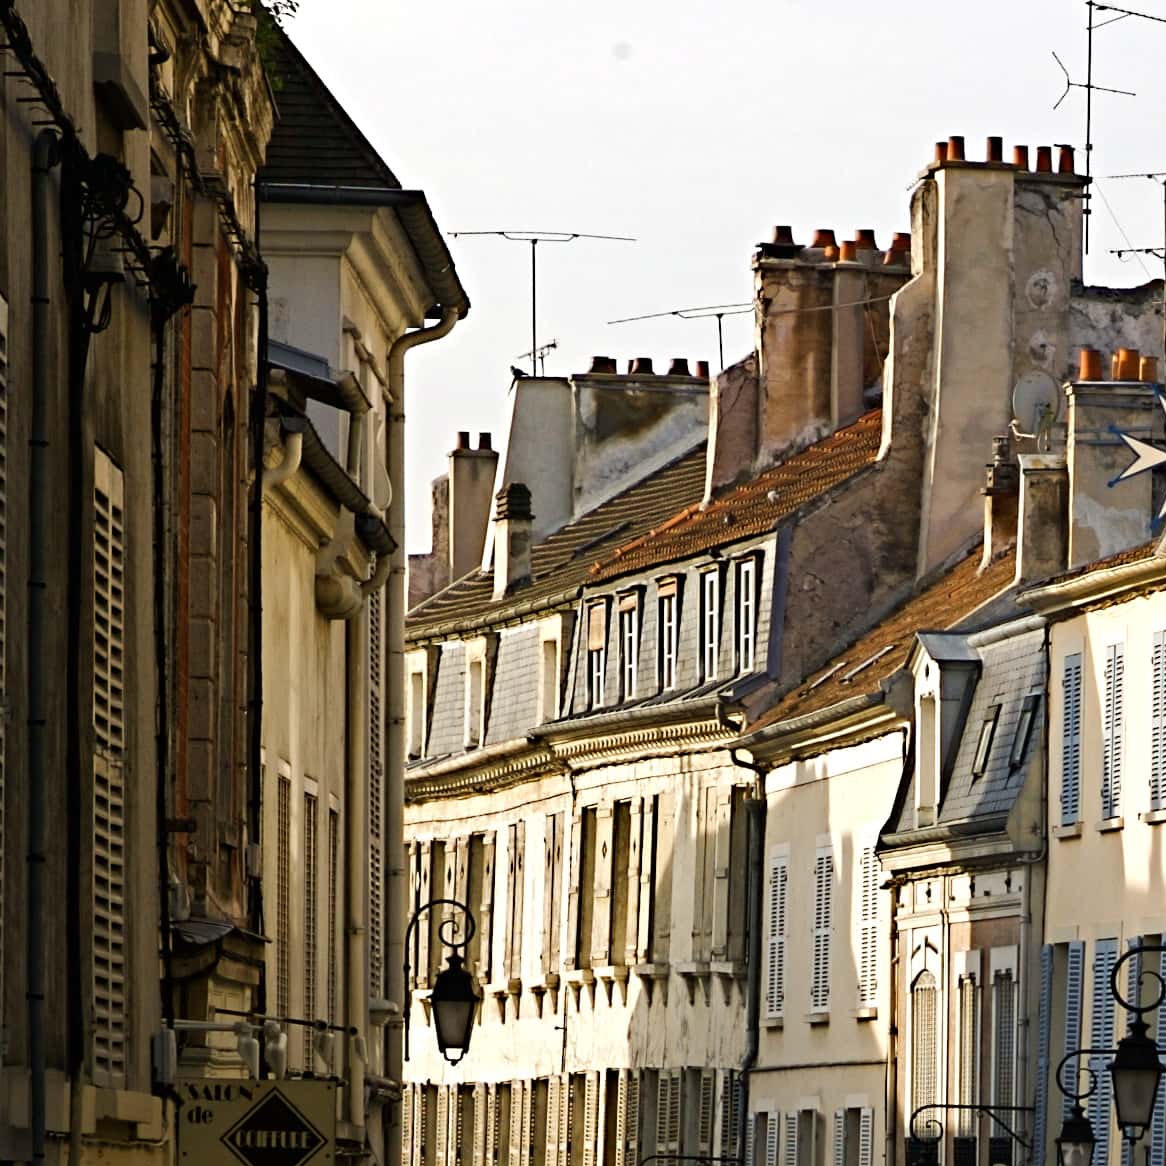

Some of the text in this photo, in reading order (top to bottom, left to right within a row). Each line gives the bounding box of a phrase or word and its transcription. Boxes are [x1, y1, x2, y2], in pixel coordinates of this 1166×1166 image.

[189, 1085, 253, 1101] SALON
[188, 1106, 213, 1124] de
[234, 1129, 312, 1149] COIFFURE
